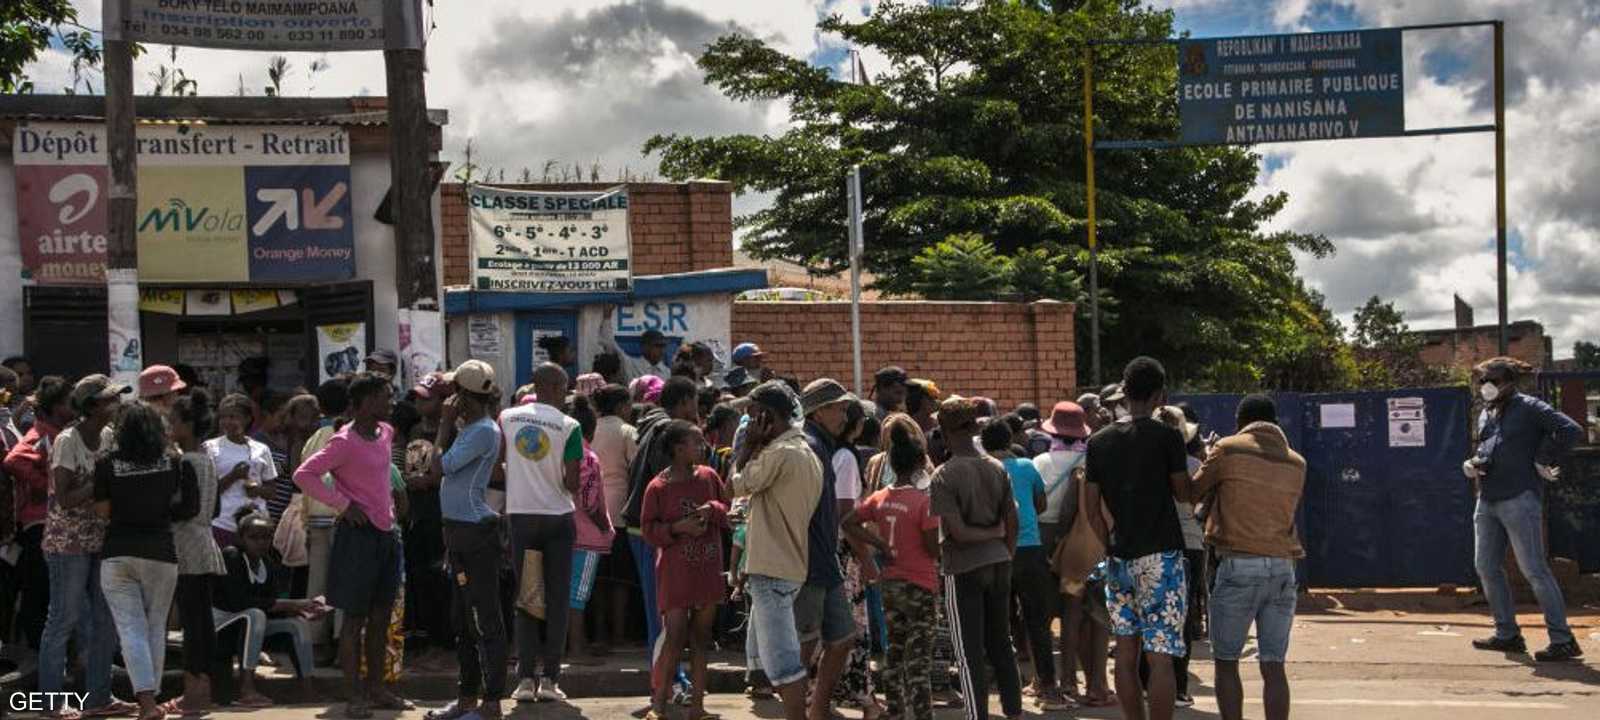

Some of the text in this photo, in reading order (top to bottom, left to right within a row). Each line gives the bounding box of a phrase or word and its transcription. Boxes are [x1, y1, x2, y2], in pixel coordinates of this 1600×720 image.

[143, 9, 275, 28] Inscription
[247, 29, 265, 41] 00
[1184, 73, 1400, 100] ECOLE PRIMAIRE PUBLIQUE
[1235, 99, 1348, 120] DE NANISANA
[1225, 119, 1360, 143] ANTANANARIVO V
[20, 130, 98, 160] Dépôt
[136, 131, 237, 154] ransfert
[262, 131, 345, 155] Retrait
[470, 191, 628, 210] CLASSE SPECIALE
[38, 228, 108, 254] airte
[254, 245, 352, 263] Orange Money
[567, 247, 575, 258] T
[579, 246, 609, 258] ACD
[617, 302, 689, 332] E.S.R
